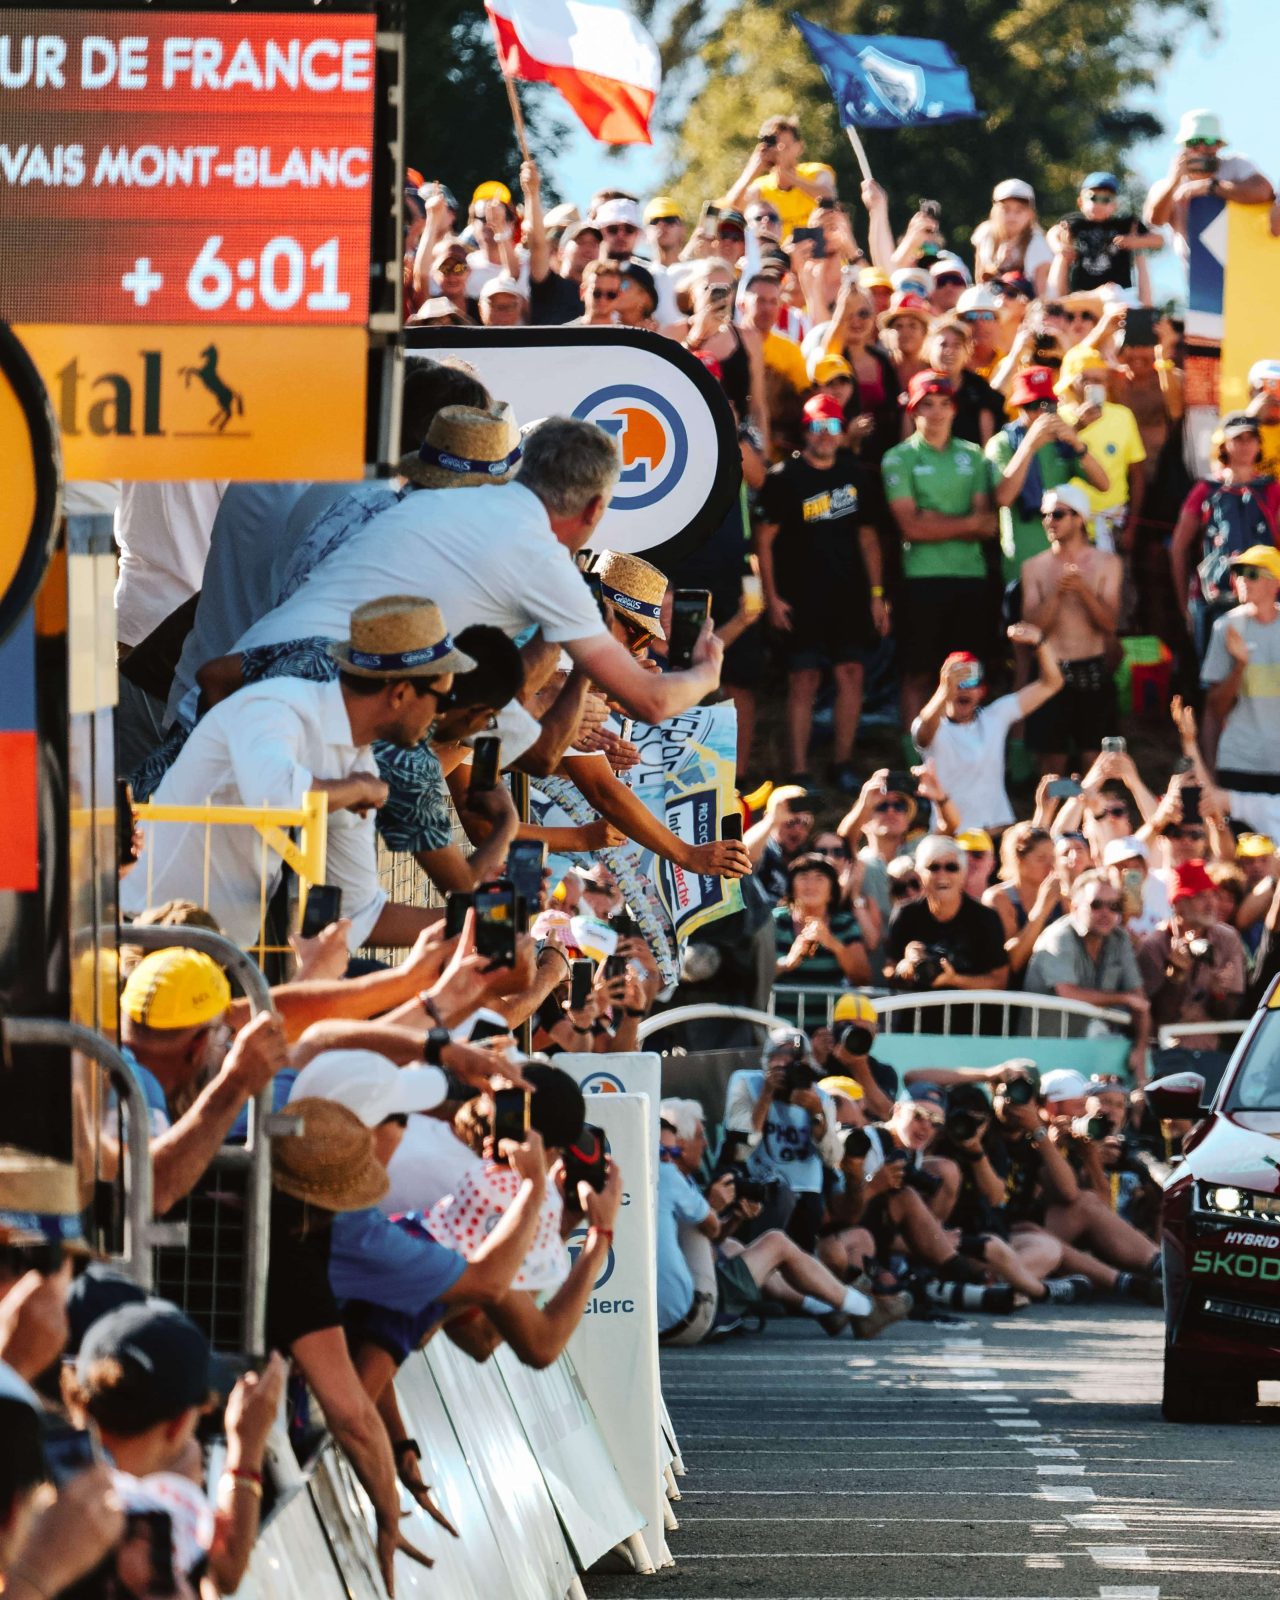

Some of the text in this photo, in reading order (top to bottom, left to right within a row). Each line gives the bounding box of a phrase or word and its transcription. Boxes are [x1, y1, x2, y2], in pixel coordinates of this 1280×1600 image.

[80, 36, 149, 90] DE
[162, 37, 373, 93] FRANCE
[93, 144, 371, 188] MONT-BLANC
[186, 234, 351, 312] 6:01
[56, 349, 166, 437] tal
[1224, 1231, 1280, 1249] HYBRID
